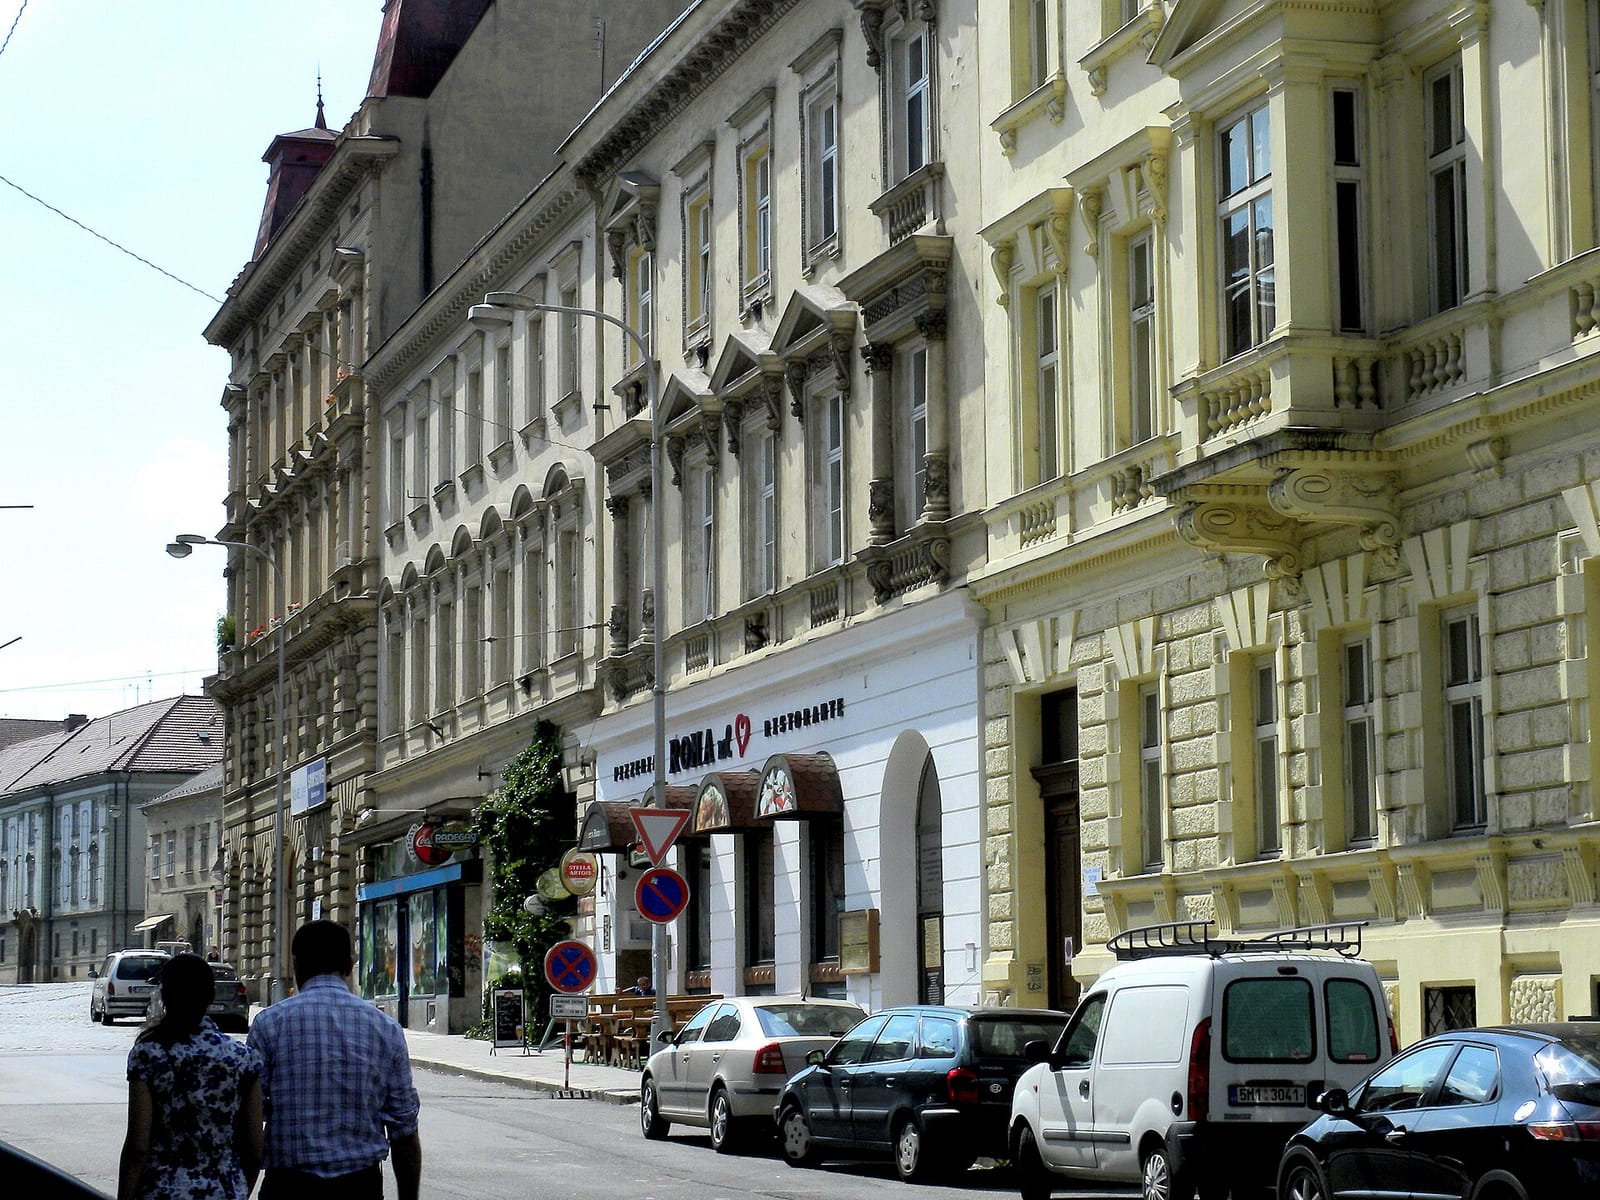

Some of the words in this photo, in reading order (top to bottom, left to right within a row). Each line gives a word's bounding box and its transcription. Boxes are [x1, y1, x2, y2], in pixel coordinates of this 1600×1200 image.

[613, 755, 655, 781] PIZZERI
[669, 728, 715, 773] ROMA
[764, 697, 845, 738] RISTORANTE
[1239, 1088, 1261, 1101] 5M1
[1270, 1088, 1299, 1101] 3041
